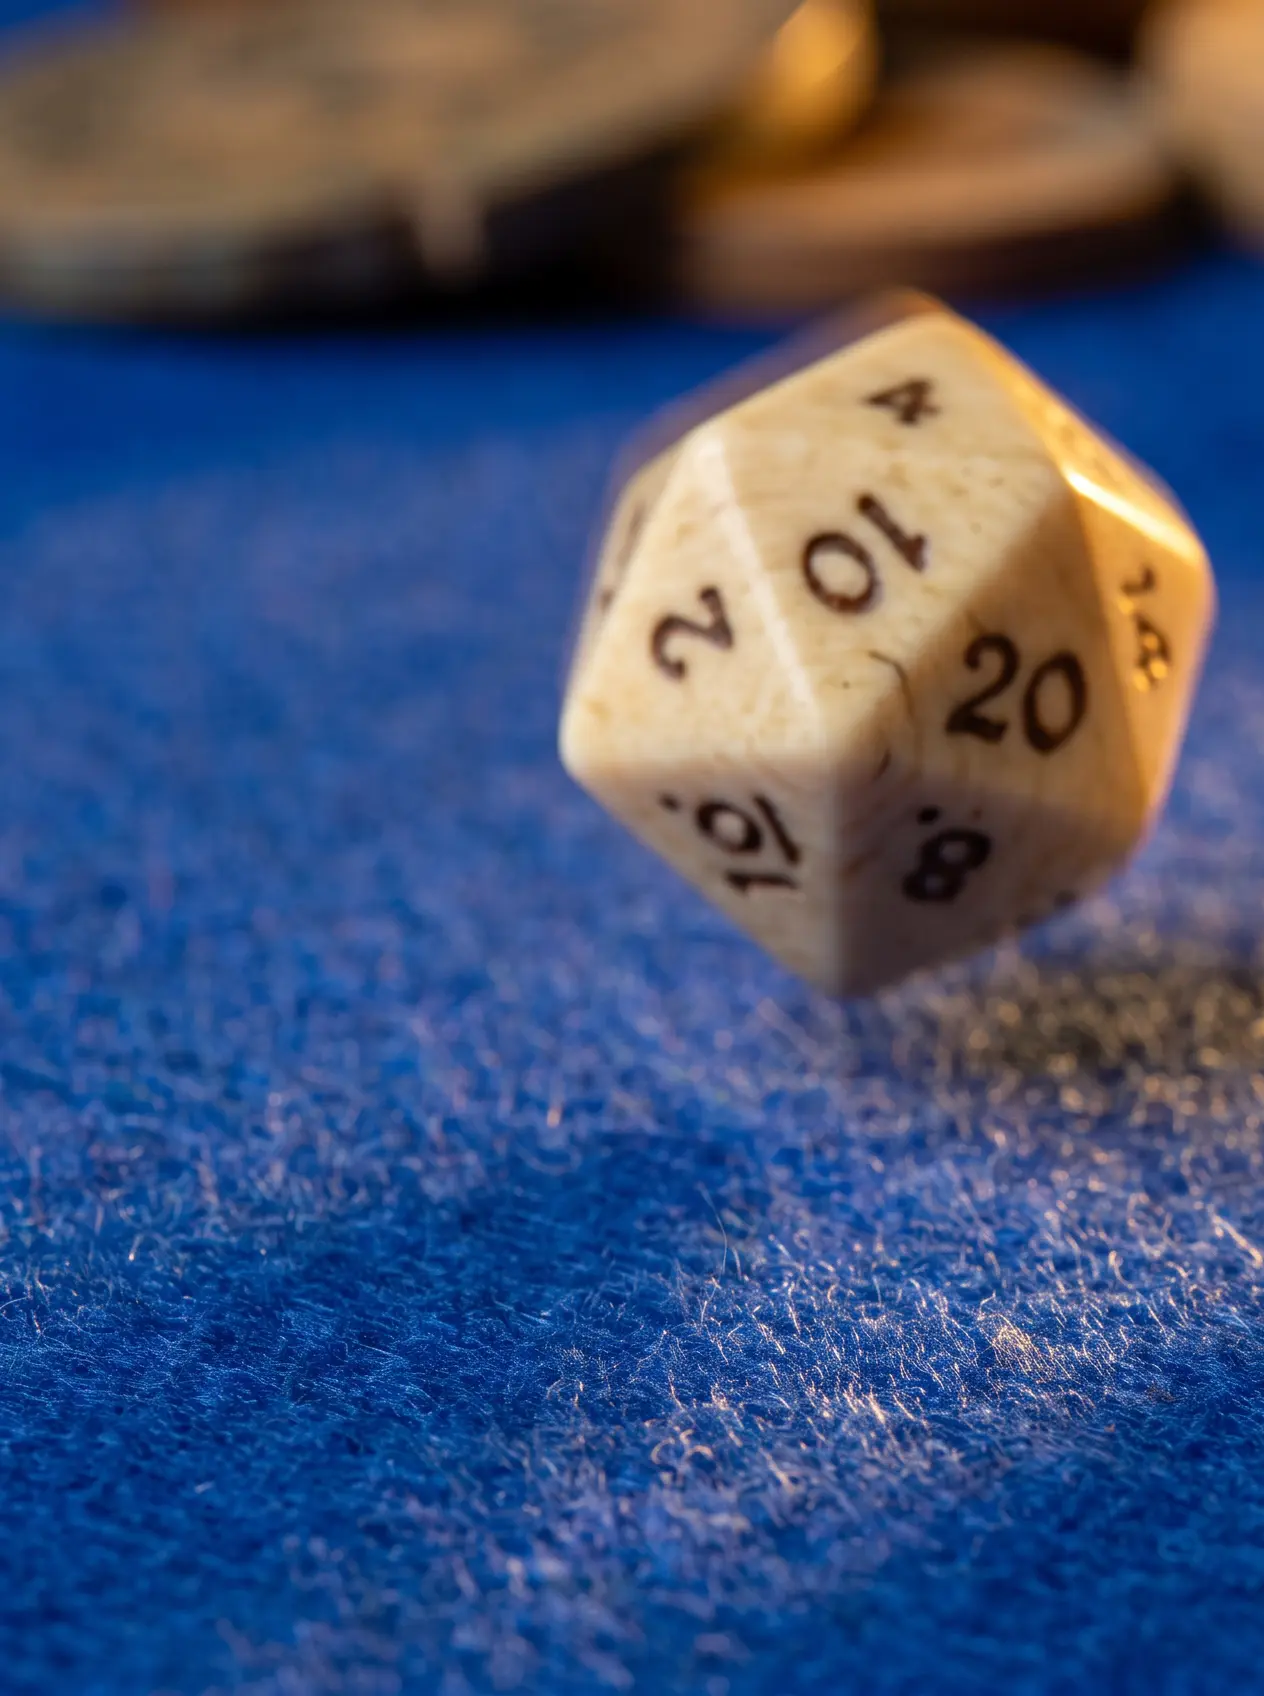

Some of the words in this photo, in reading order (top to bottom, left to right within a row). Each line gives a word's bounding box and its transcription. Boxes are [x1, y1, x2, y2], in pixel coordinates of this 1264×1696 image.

[865, 376, 942, 427] 4
[802, 494, 930, 615] 10
[650, 585, 734, 679] 2
[945, 634, 1088, 756] 20
